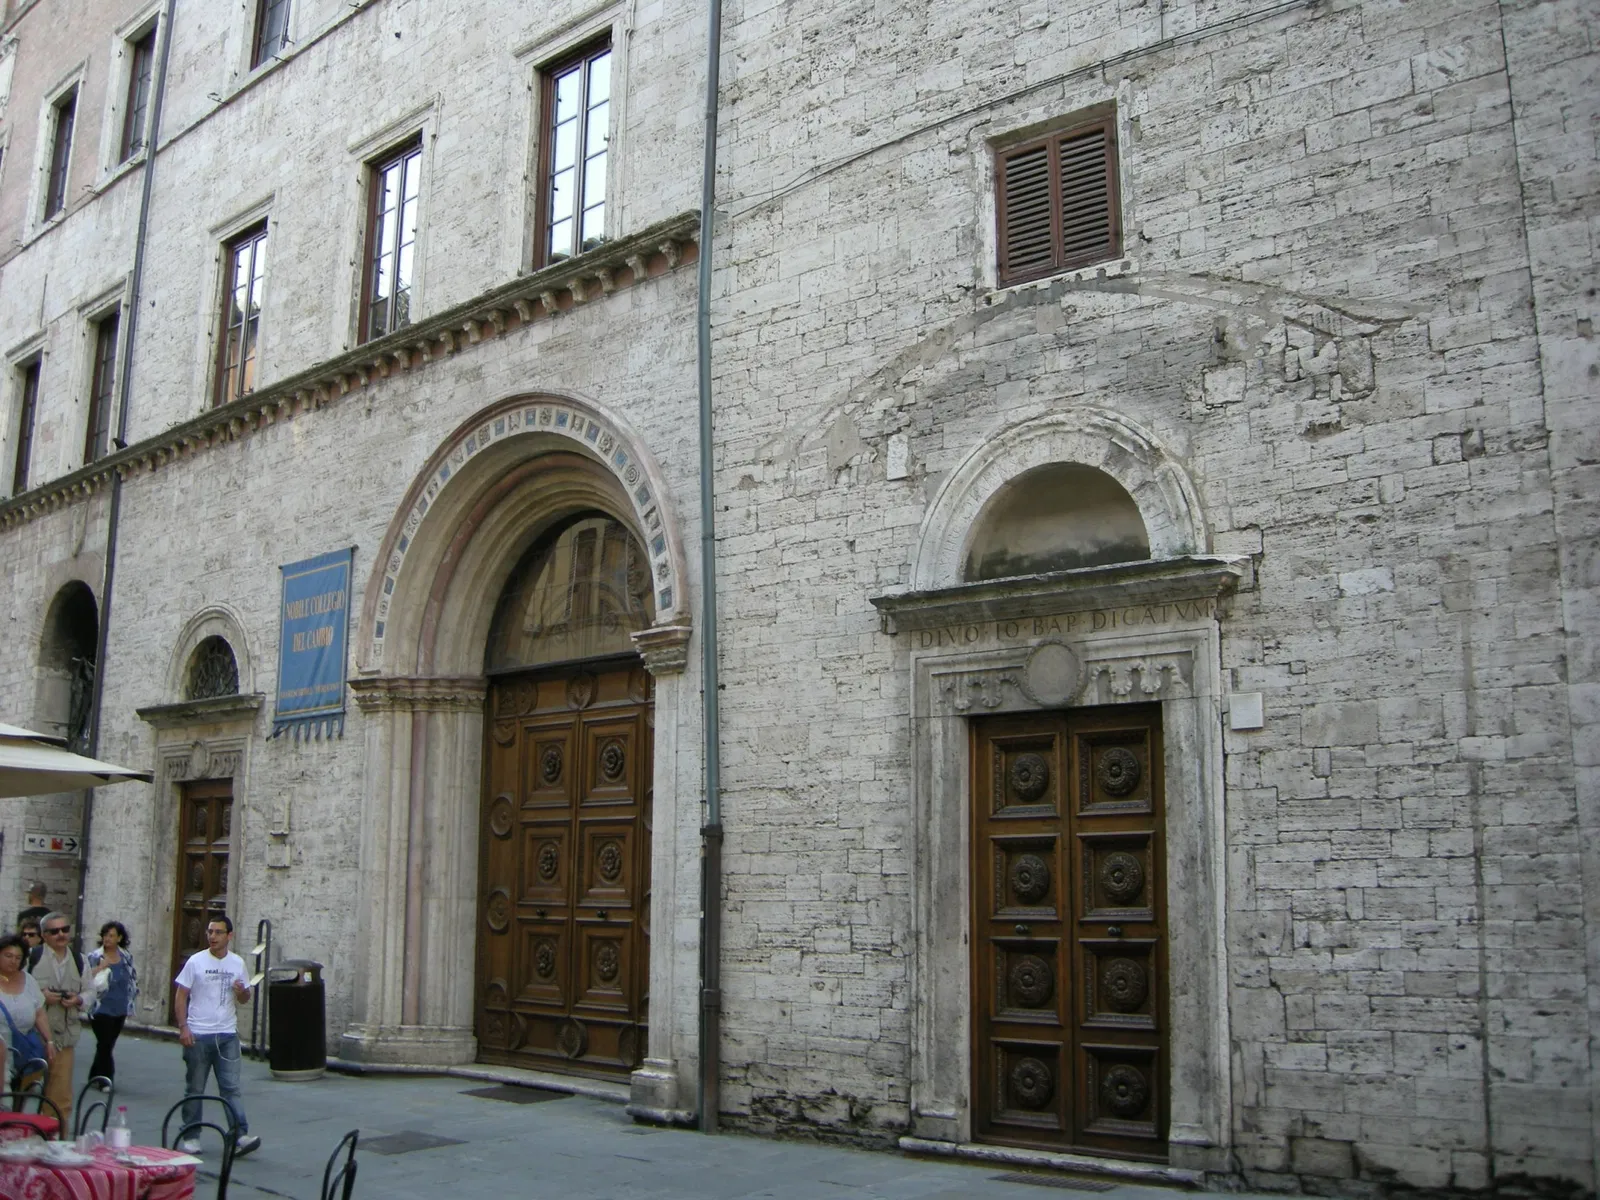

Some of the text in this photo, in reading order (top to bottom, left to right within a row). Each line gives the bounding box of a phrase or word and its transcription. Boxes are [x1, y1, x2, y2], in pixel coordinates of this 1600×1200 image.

[286, 589, 345, 620] NOBILE COLLEGIO
[293, 625, 334, 653] DEL CAMBIO
[919, 625, 979, 650] DIVO
[995, 621, 1020, 641] IO
